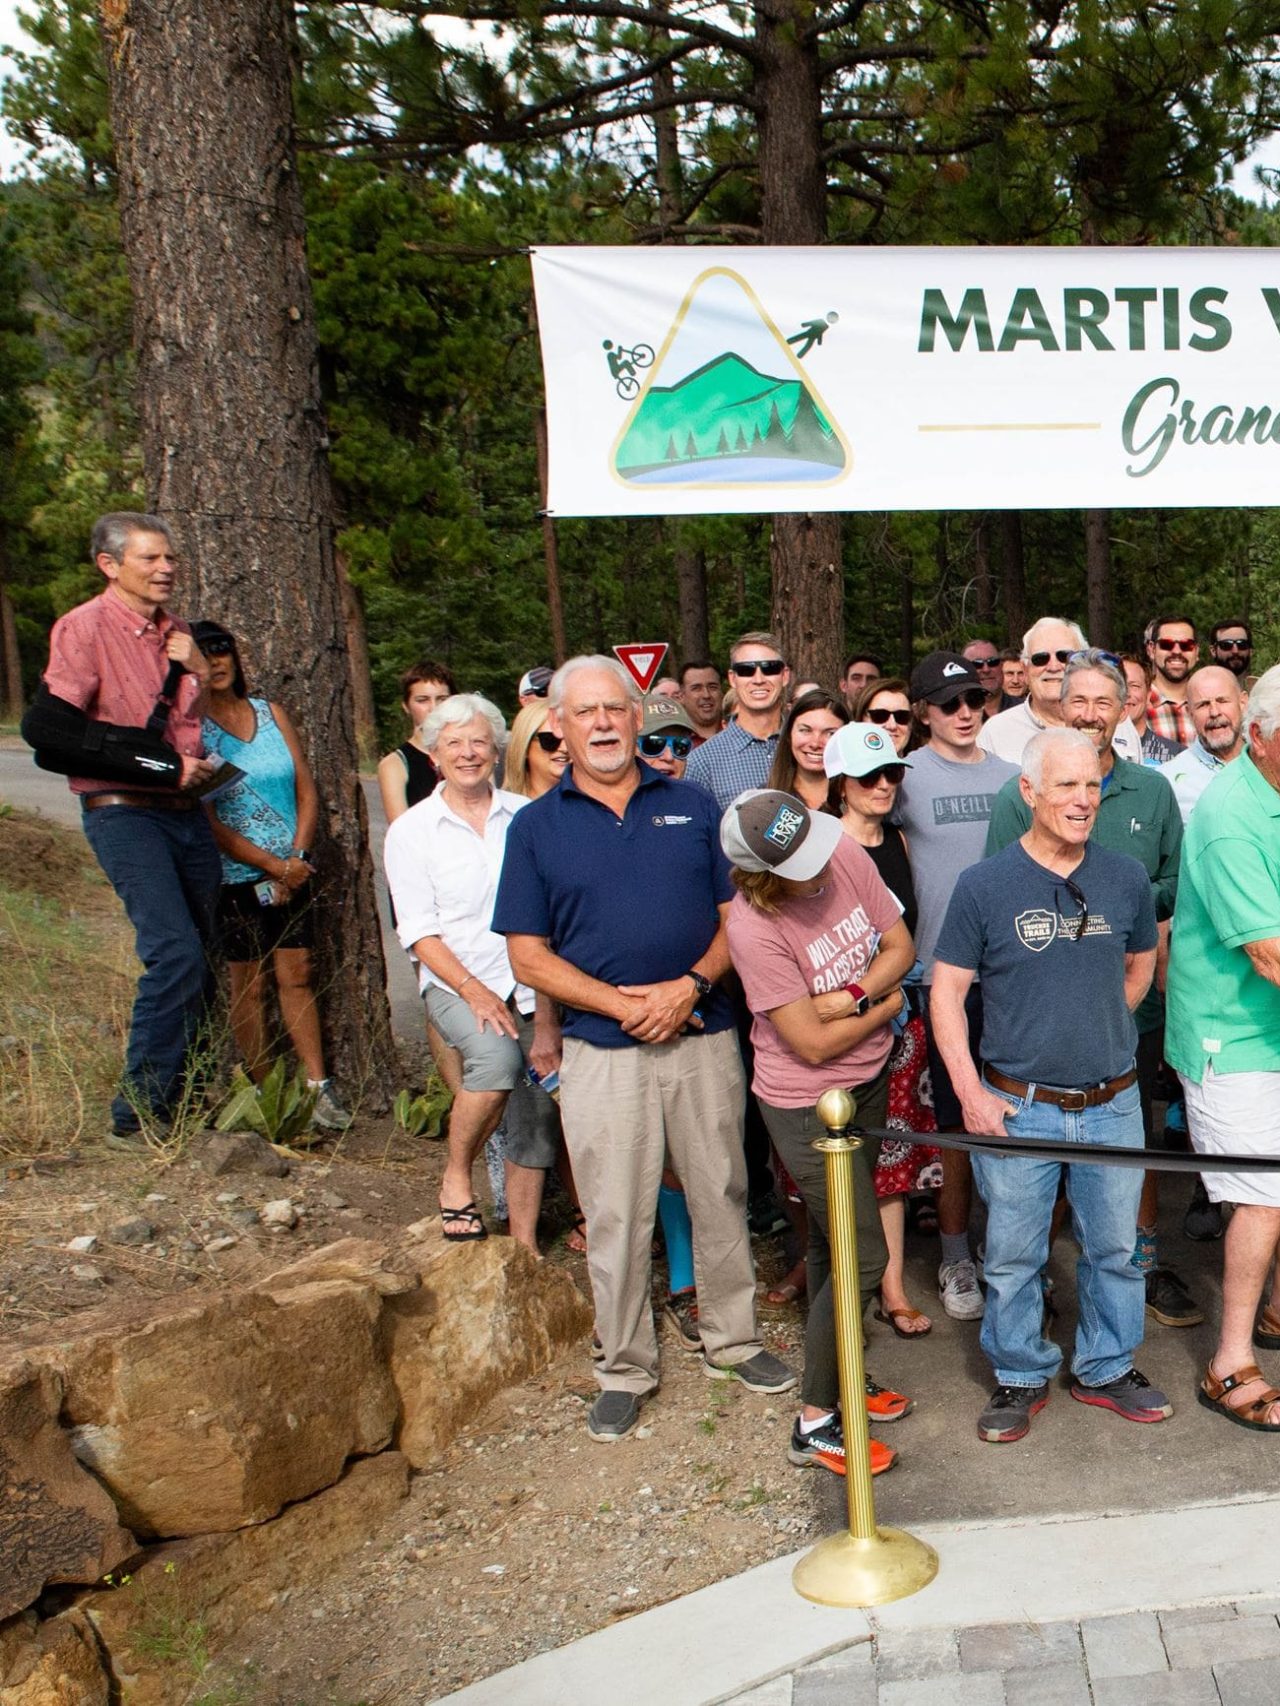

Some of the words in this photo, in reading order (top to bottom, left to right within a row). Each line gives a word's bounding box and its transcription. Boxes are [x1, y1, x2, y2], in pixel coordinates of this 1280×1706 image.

[918, 287, 1232, 353] MARTIS
[935, 796, 992, 816] O'NEILL
[769, 808, 794, 839] HIGHER
[1060, 918, 1105, 927] CONNTING
[1070, 924, 1111, 933] COMUNITY
[805, 932, 841, 971] WILL
[832, 904, 870, 945] TRAD
[1023, 928, 1051, 938] TRAILS
[807, 1436, 847, 1457] MERRE
